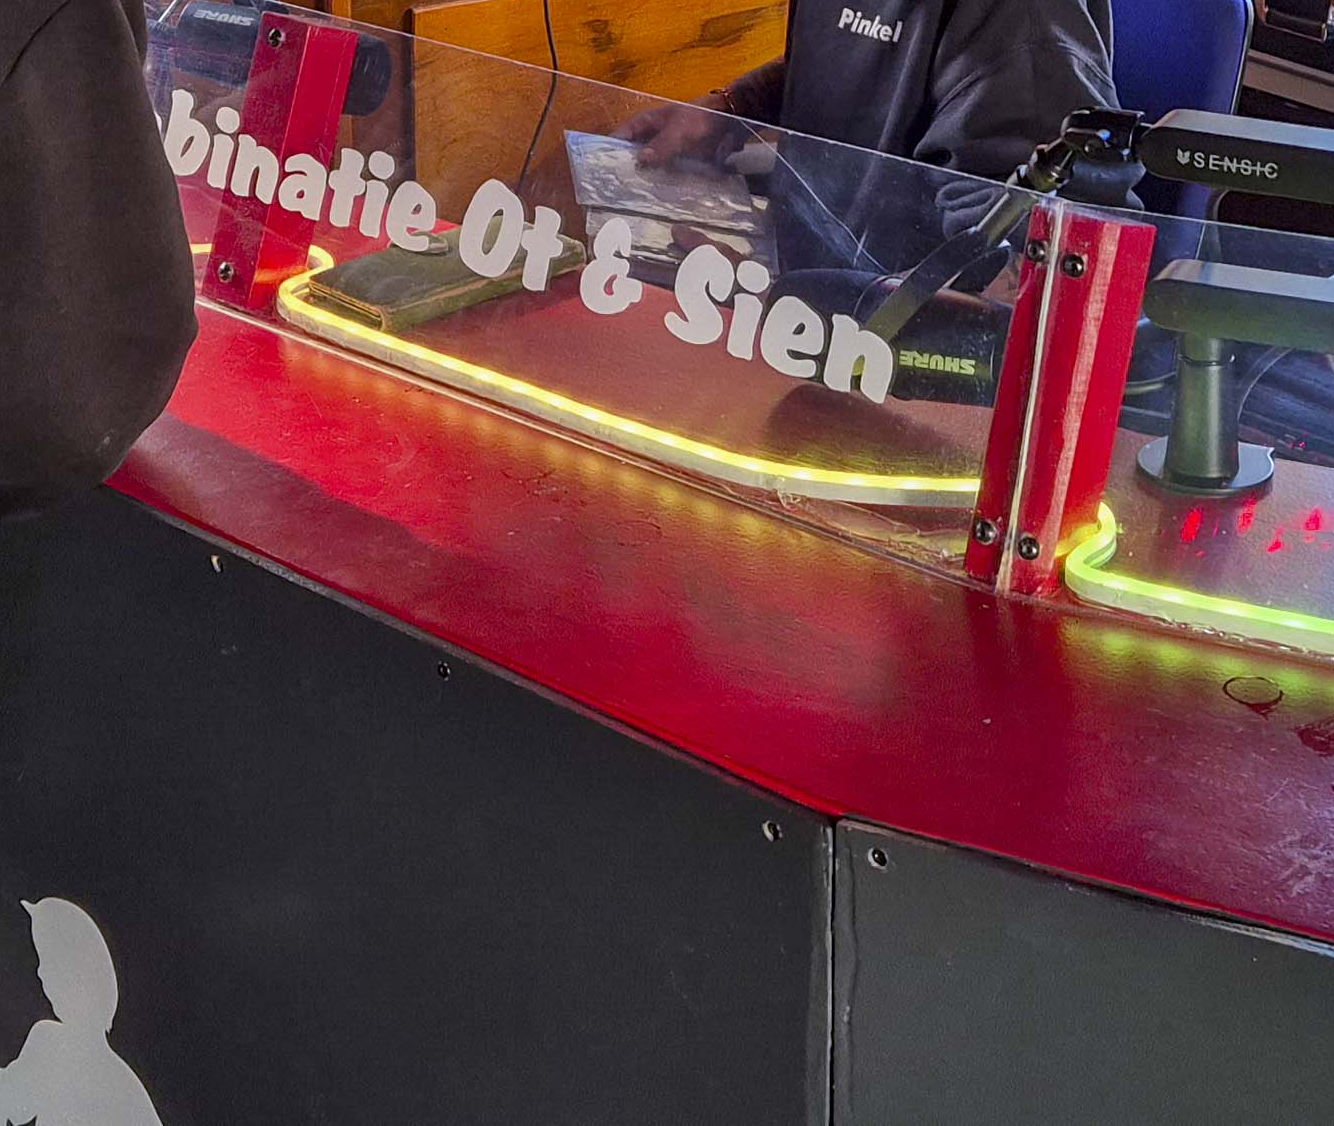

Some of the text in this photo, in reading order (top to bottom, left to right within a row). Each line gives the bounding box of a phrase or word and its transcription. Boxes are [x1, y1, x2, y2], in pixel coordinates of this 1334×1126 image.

[838, 7, 903, 42] Pinkel
[1193, 151, 1279, 179] SENSIC
[155, 88, 893, 404] binatie Ot & Sien
[899, 349, 976, 375] SHURE
